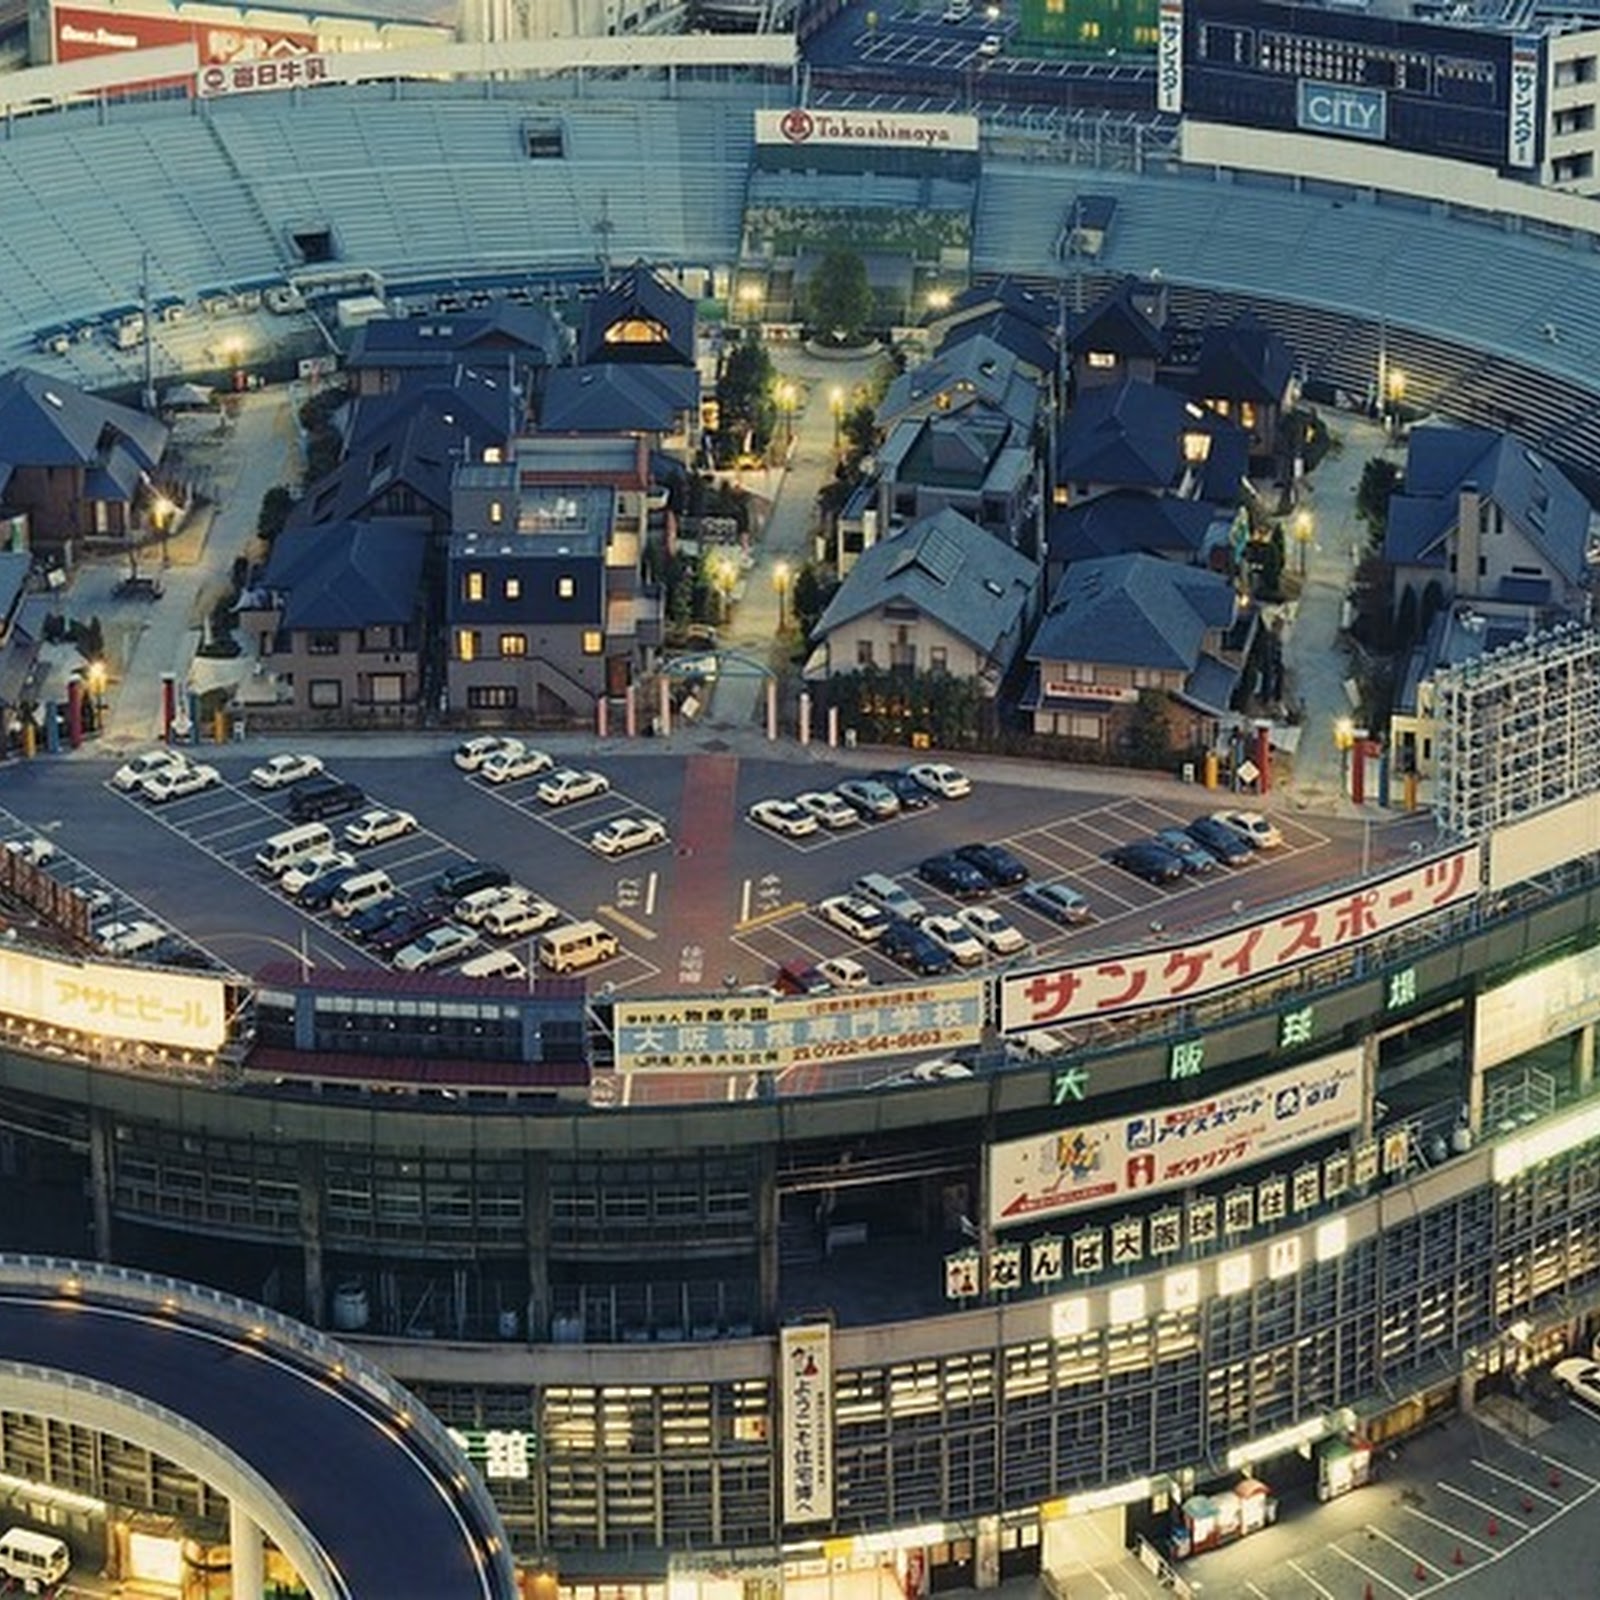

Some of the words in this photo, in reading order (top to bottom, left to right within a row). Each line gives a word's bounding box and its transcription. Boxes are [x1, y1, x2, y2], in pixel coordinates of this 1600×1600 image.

[233, 57, 327, 88] 毎日牛乳
[816, 116, 950, 146] Takashimaya
[1309, 97, 1378, 130] CITY
[1024, 855, 1467, 1021] サンケイスポーツ
[55, 979, 210, 1027] アサヒビール
[1054, 968, 1419, 1105] 大阪球場
